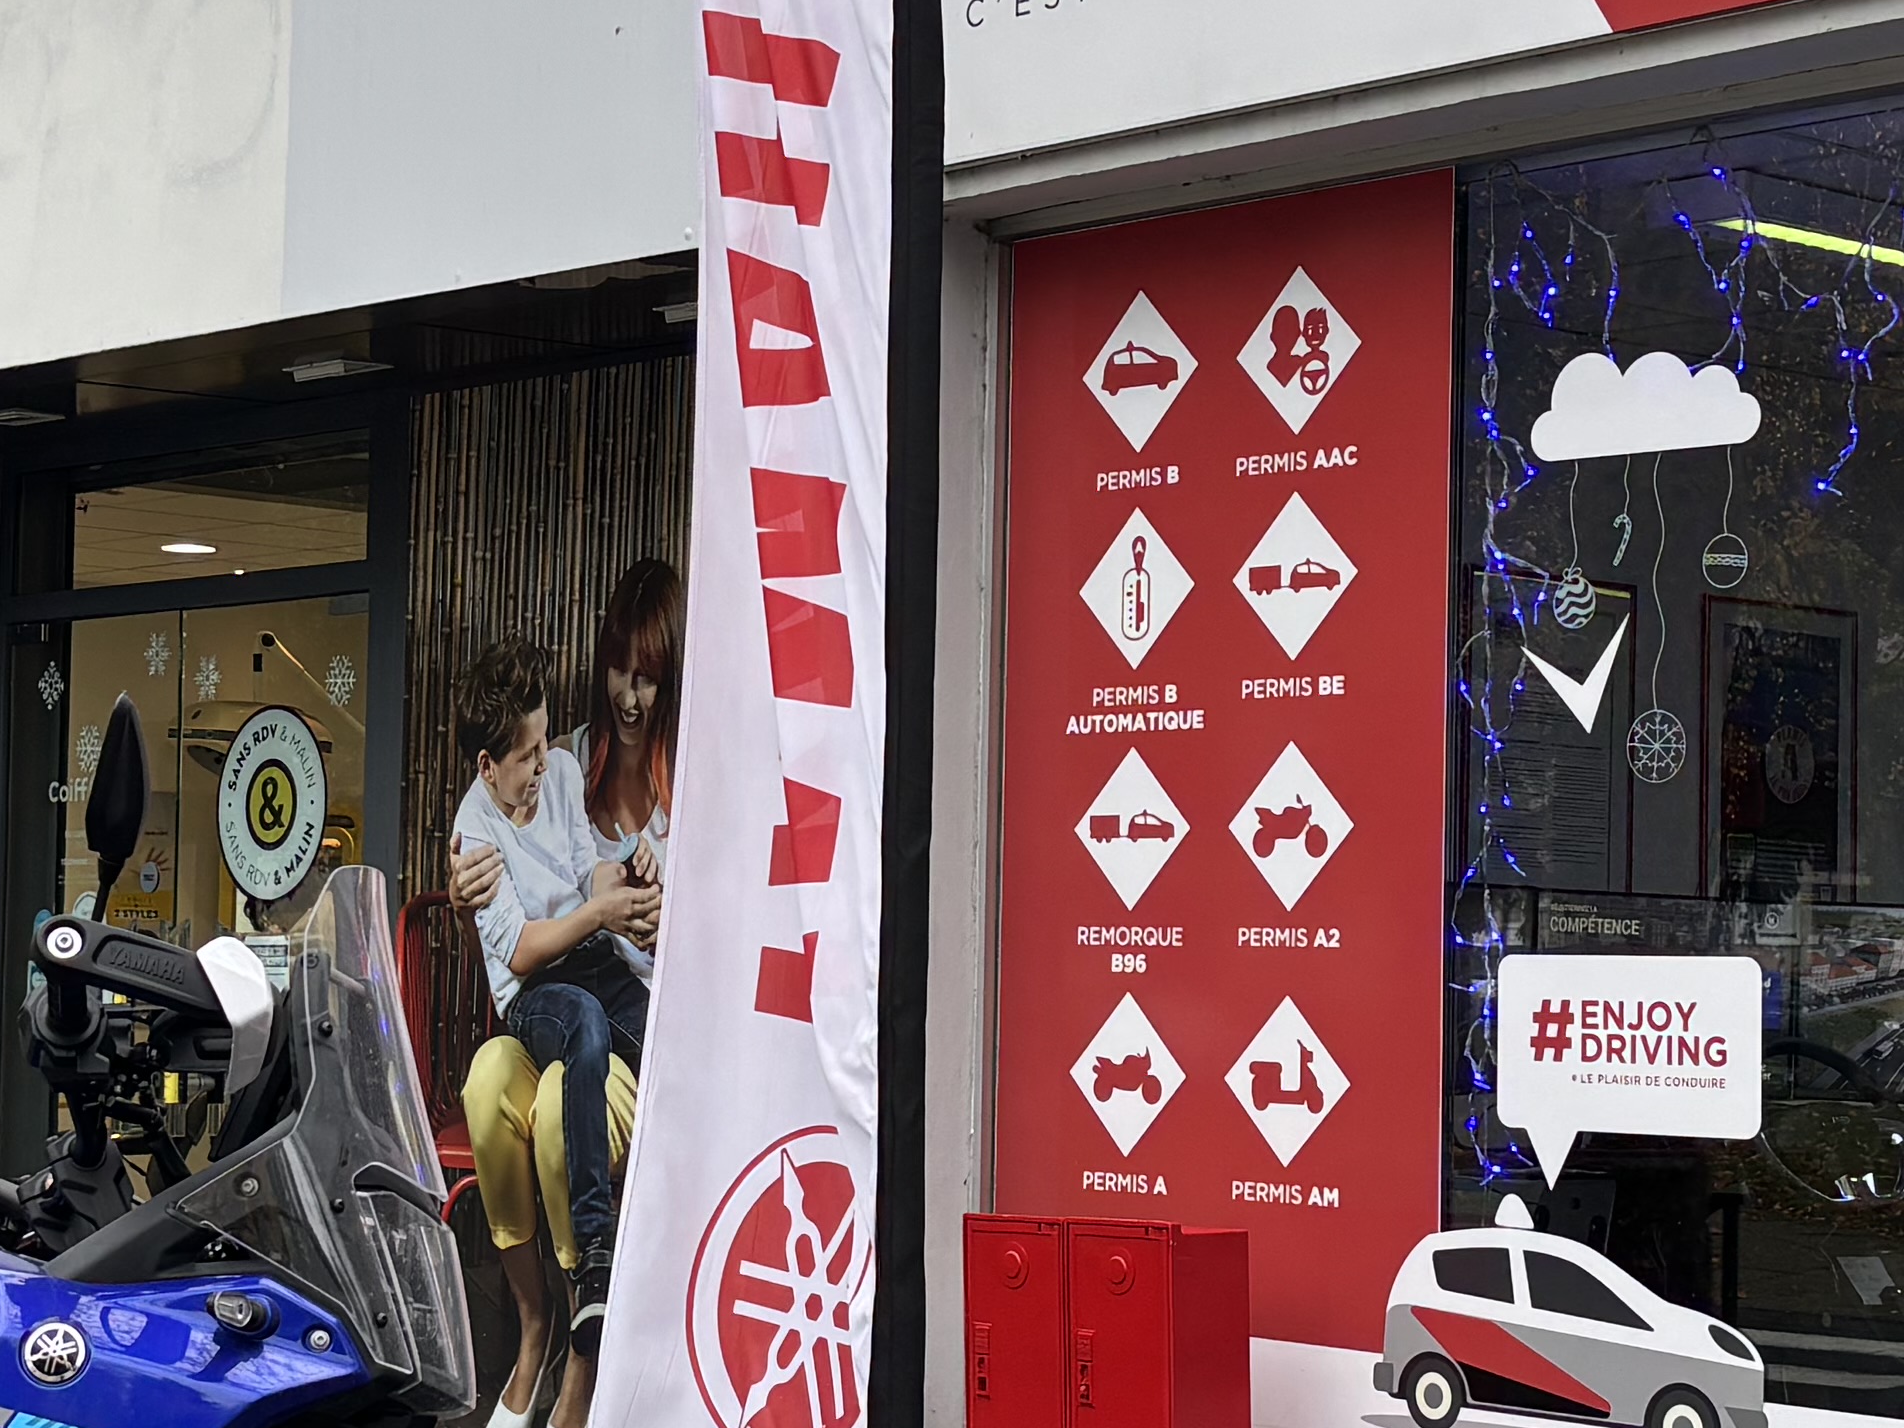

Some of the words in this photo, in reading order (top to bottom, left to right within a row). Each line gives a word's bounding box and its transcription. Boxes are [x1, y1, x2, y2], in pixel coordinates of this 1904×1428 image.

[1236, 451, 1308, 477] PERMIS
[1313, 446, 1358, 470] AAC
[1096, 469, 1162, 492] PERMIS
[1166, 466, 1180, 484] B
[1092, 686, 1160, 708] PERMIS
[1164, 684, 1178, 703] B
[1241, 677, 1313, 700] PERMIS
[1318, 675, 1345, 696] BE
[1065, 710, 1205, 735] AUTOMATIQUE
[228, 742, 251, 792] SANS
[252, 724, 278, 747] RDV
[289, 732, 316, 789] MALIN
[48, 778, 89, 803] Coiff
[258, 776, 285, 831] &
[226, 821, 247, 870] SANS
[246, 863, 271, 886] RDV
[285, 822, 315, 878] MALIN
[1076, 925, 1184, 947] REMORQUE
[1237, 927, 1309, 948] PERMIS
[1313, 927, 1341, 948] A2
[1550, 914, 1641, 936] COMPÉTENCE
[108, 943, 185, 984] YAMAHA
[1111, 953, 1147, 973] B96
[1581, 1000, 1697, 1033] ENJOY
[1581, 1033, 1727, 1067] DRIVING
[1581, 1074, 1593, 1084] LE
[1598, 1074, 1642, 1086] PLAISIR
[1646, 1076, 1661, 1087] DE
[1665, 1076, 1726, 1089] CONDUIRE
[1082, 1172, 1149, 1194] PERMIS
[1152, 1175, 1168, 1195] A
[1231, 1181, 1303, 1205] PERMIS
[1307, 1187, 1340, 1208] AM
